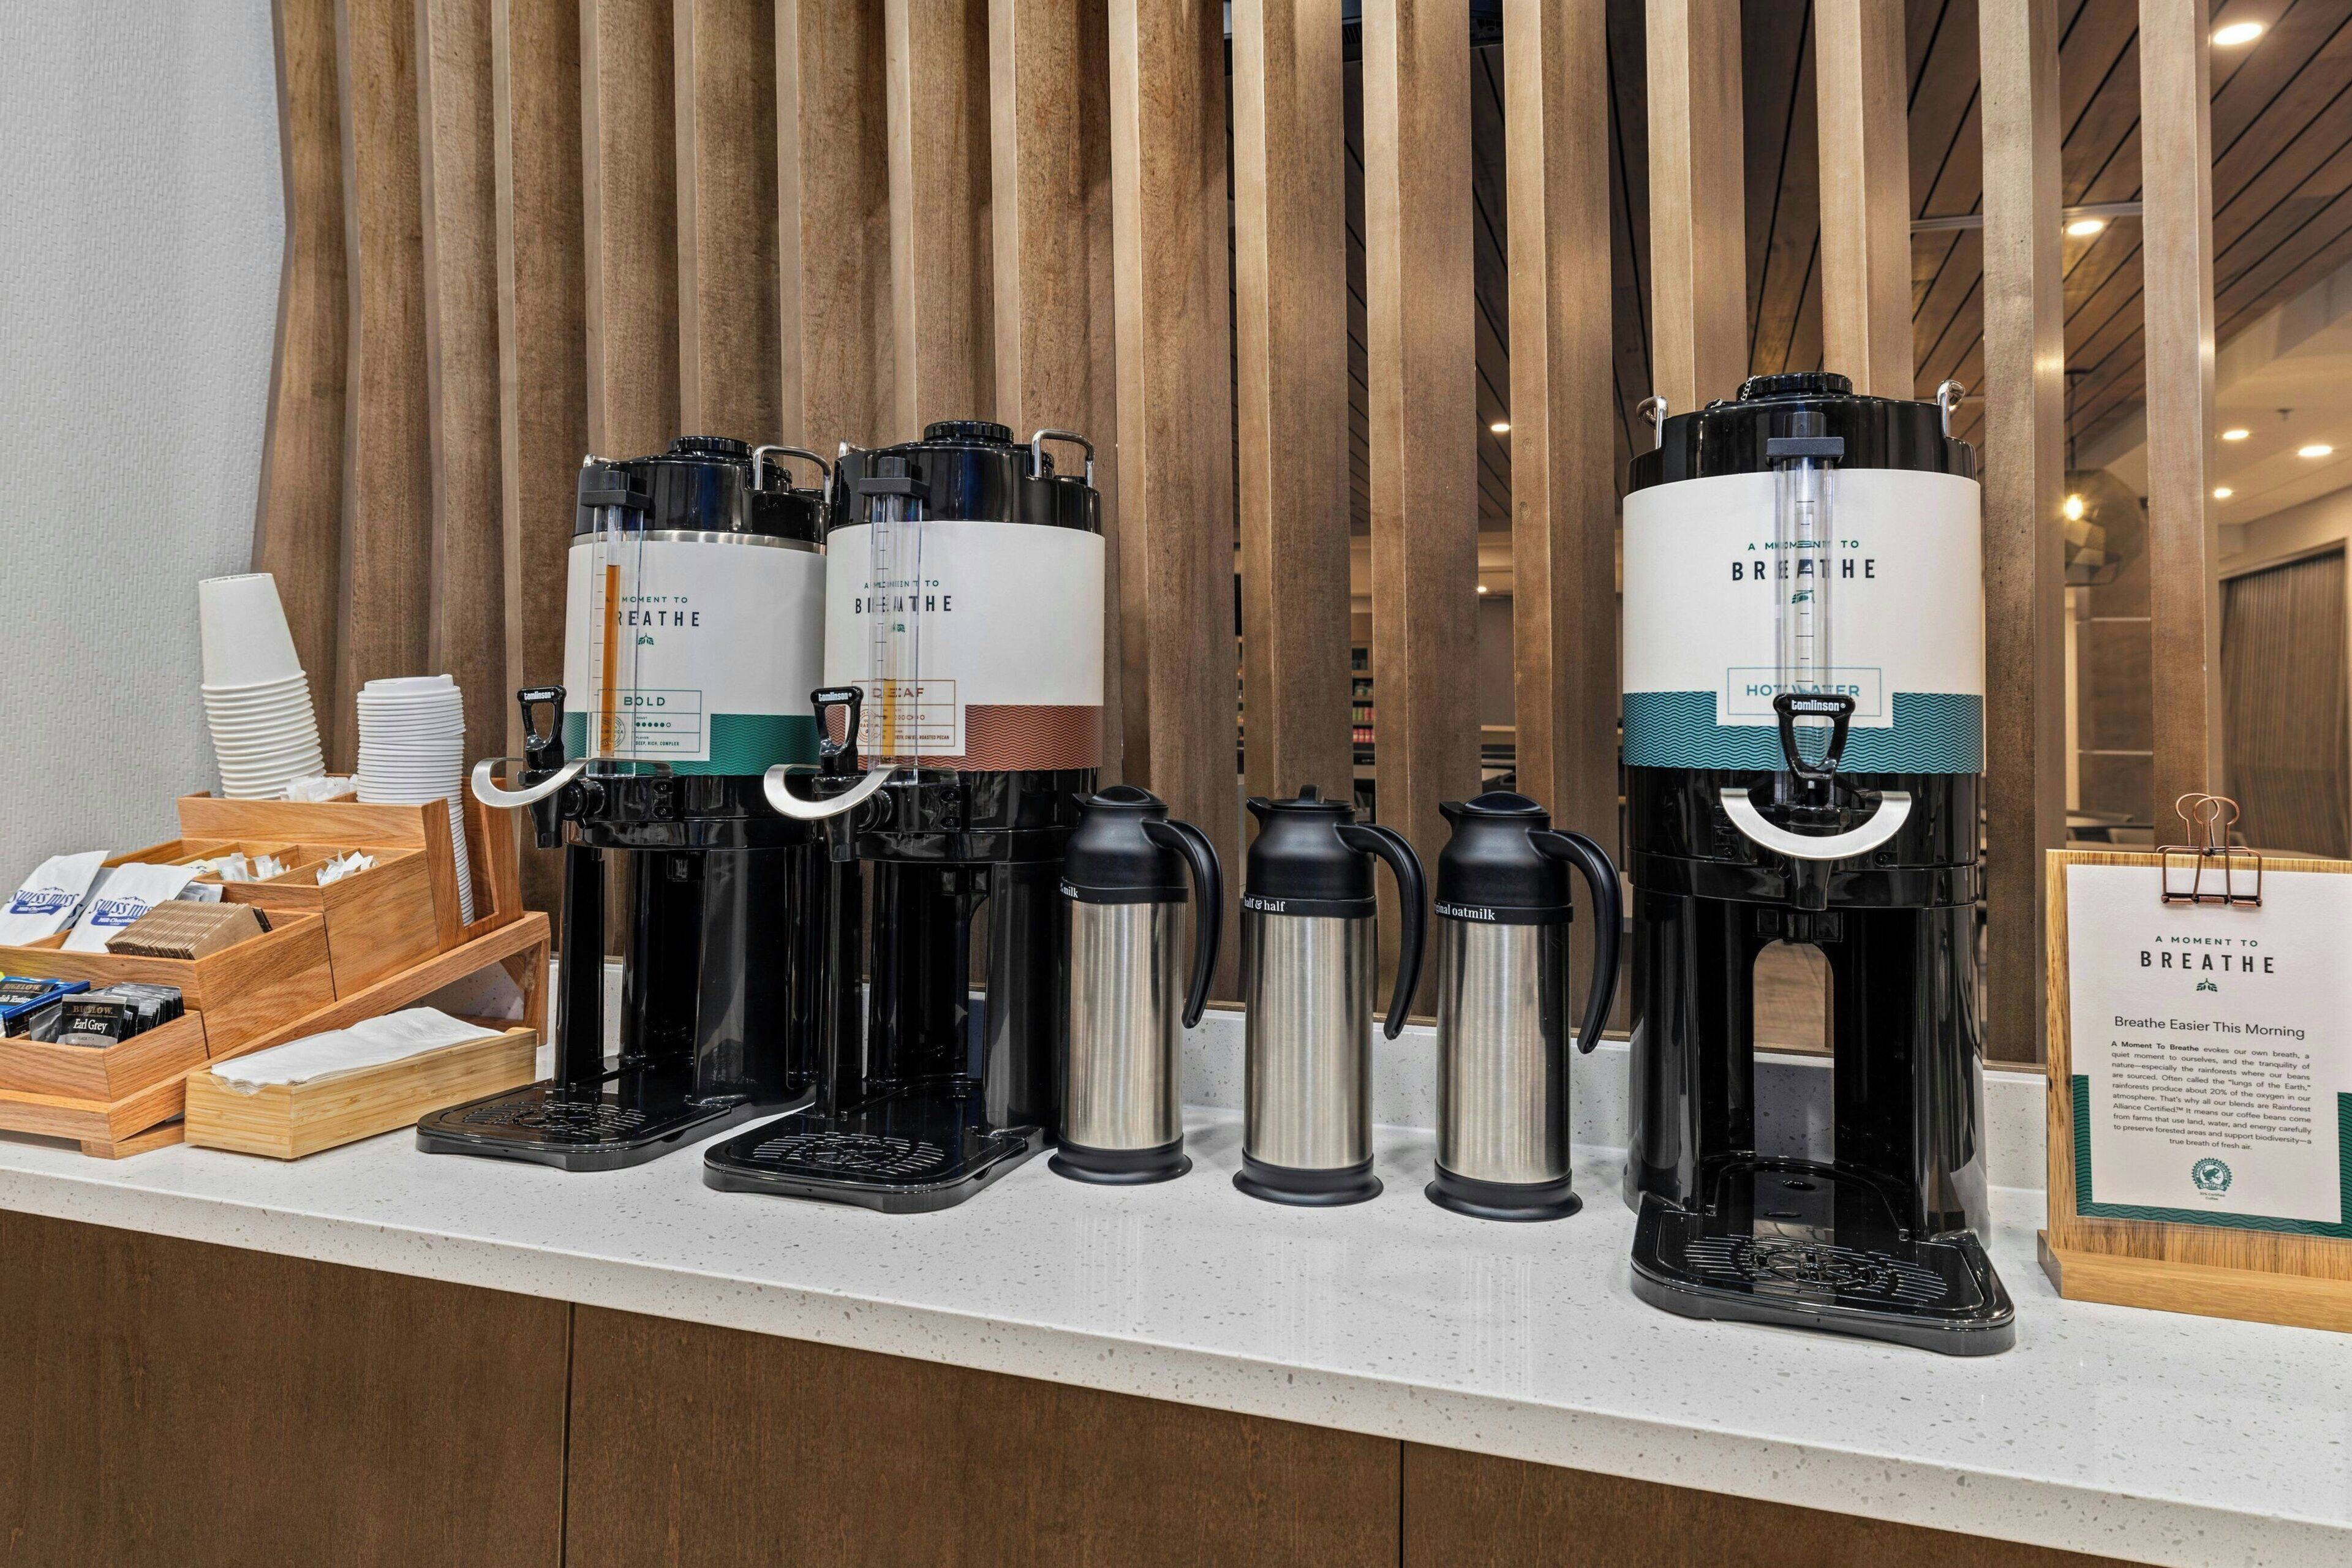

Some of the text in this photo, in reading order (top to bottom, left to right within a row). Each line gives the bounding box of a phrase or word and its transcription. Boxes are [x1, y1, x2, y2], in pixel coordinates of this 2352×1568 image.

[1732, 559, 1875, 581] BREATHE
[624, 697, 665, 706] BOLD
[1064, 886, 1078, 898] milk
[1245, 896, 1286, 911] half & half
[1452, 908, 1495, 921] oatmilk
[2171, 937, 2231, 946] MOMENT
[2141, 951, 2274, 973] BREATHE
[73, 1019, 108, 1033] Earl Grey
[2115, 1016, 2305, 1040] Breathe Easier This Morning
[2260, 1061, 2297, 1069] tranquility
[2152, 1085, 2182, 1094] produce
[2272, 1104, 2310, 1112] Rainforest
